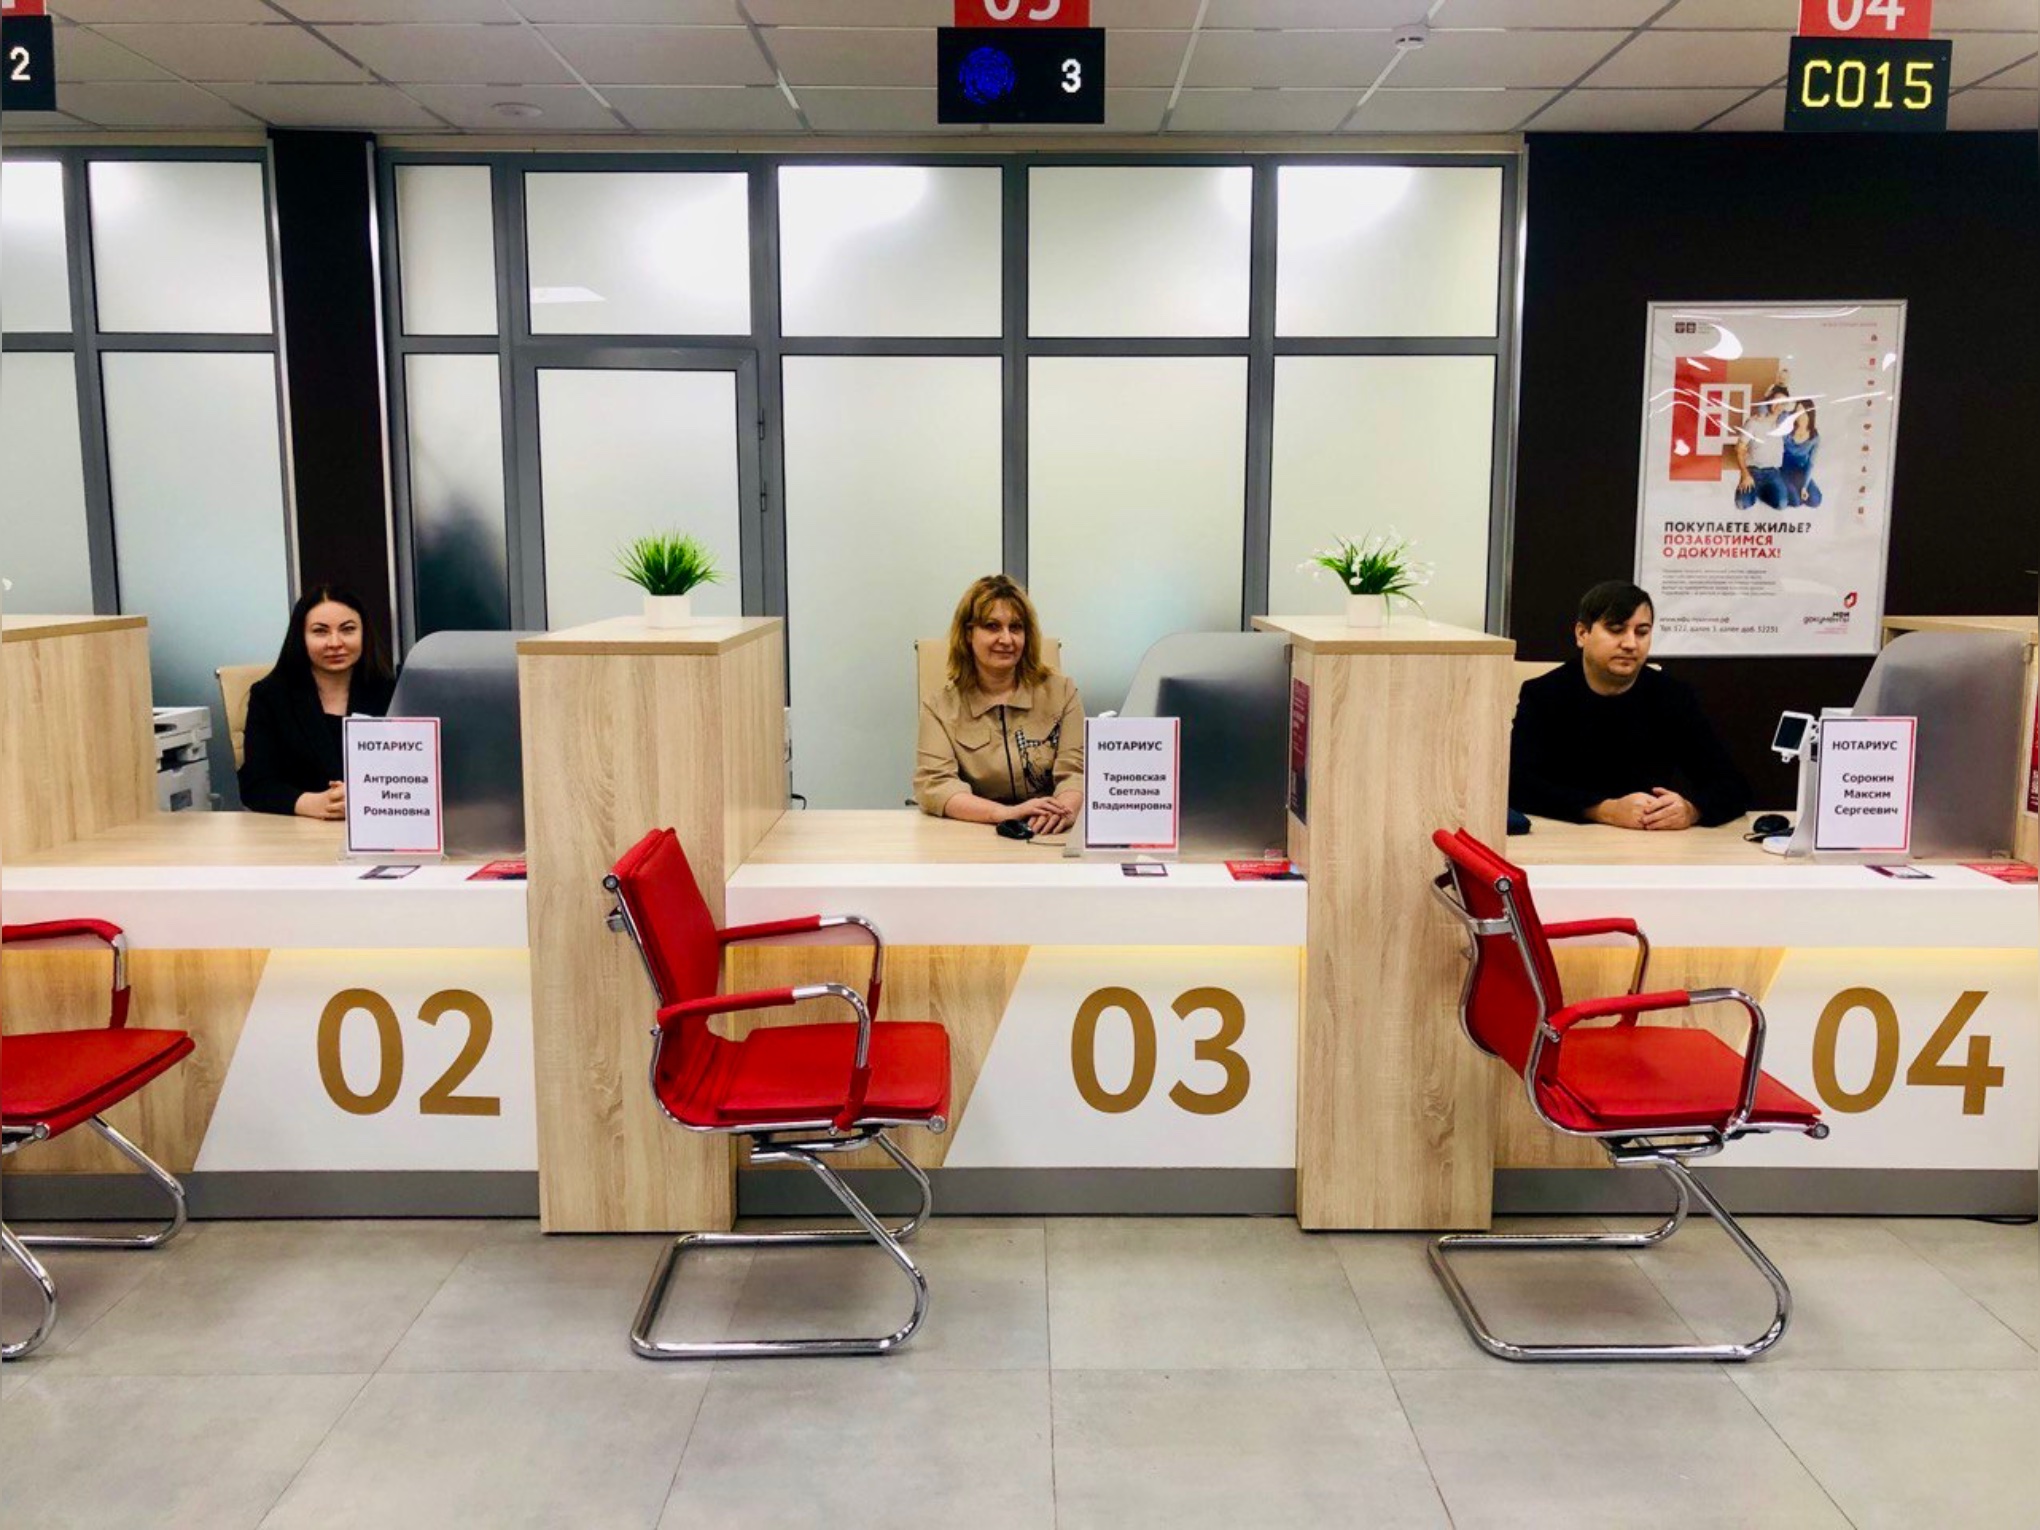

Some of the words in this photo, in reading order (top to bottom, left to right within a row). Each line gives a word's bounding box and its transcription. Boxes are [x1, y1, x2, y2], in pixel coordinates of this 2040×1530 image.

[10, 46, 31, 81] 2
[1061, 58, 1082, 93] 3
[1664, 522, 1750, 533] ПОКУПАЕТЕ
[1754, 522, 1812, 533] ЖИЛЬЕ?
[1663, 535, 1774, 546] ПОЗАБОТИМСЯ
[1662, 547, 1674, 558] О
[1677, 547, 1782, 559] ДОКУМЕНТАХ!
[357, 740, 424, 752] НОТАРИУС
[1097, 740, 1163, 752] НОТАРИУС
[1832, 740, 1898, 751] НОТАРИУС
[363, 773, 430, 786] Антропова
[1103, 772, 1167, 784] Тарновская
[1842, 772, 1895, 784] Сорокин
[381, 790, 412, 801] Инга
[1108, 787, 1161, 797] Светлана
[1843, 789, 1892, 800] Максим
[363, 805, 431, 817] Романовна
[1092, 801, 1173, 813] Владимировна
[1834, 804, 1899, 816] Сергеевич
[316, 987, 500, 1116] 02
[1070, 986, 1251, 1115] 03
[1812, 986, 2005, 1115] 04
